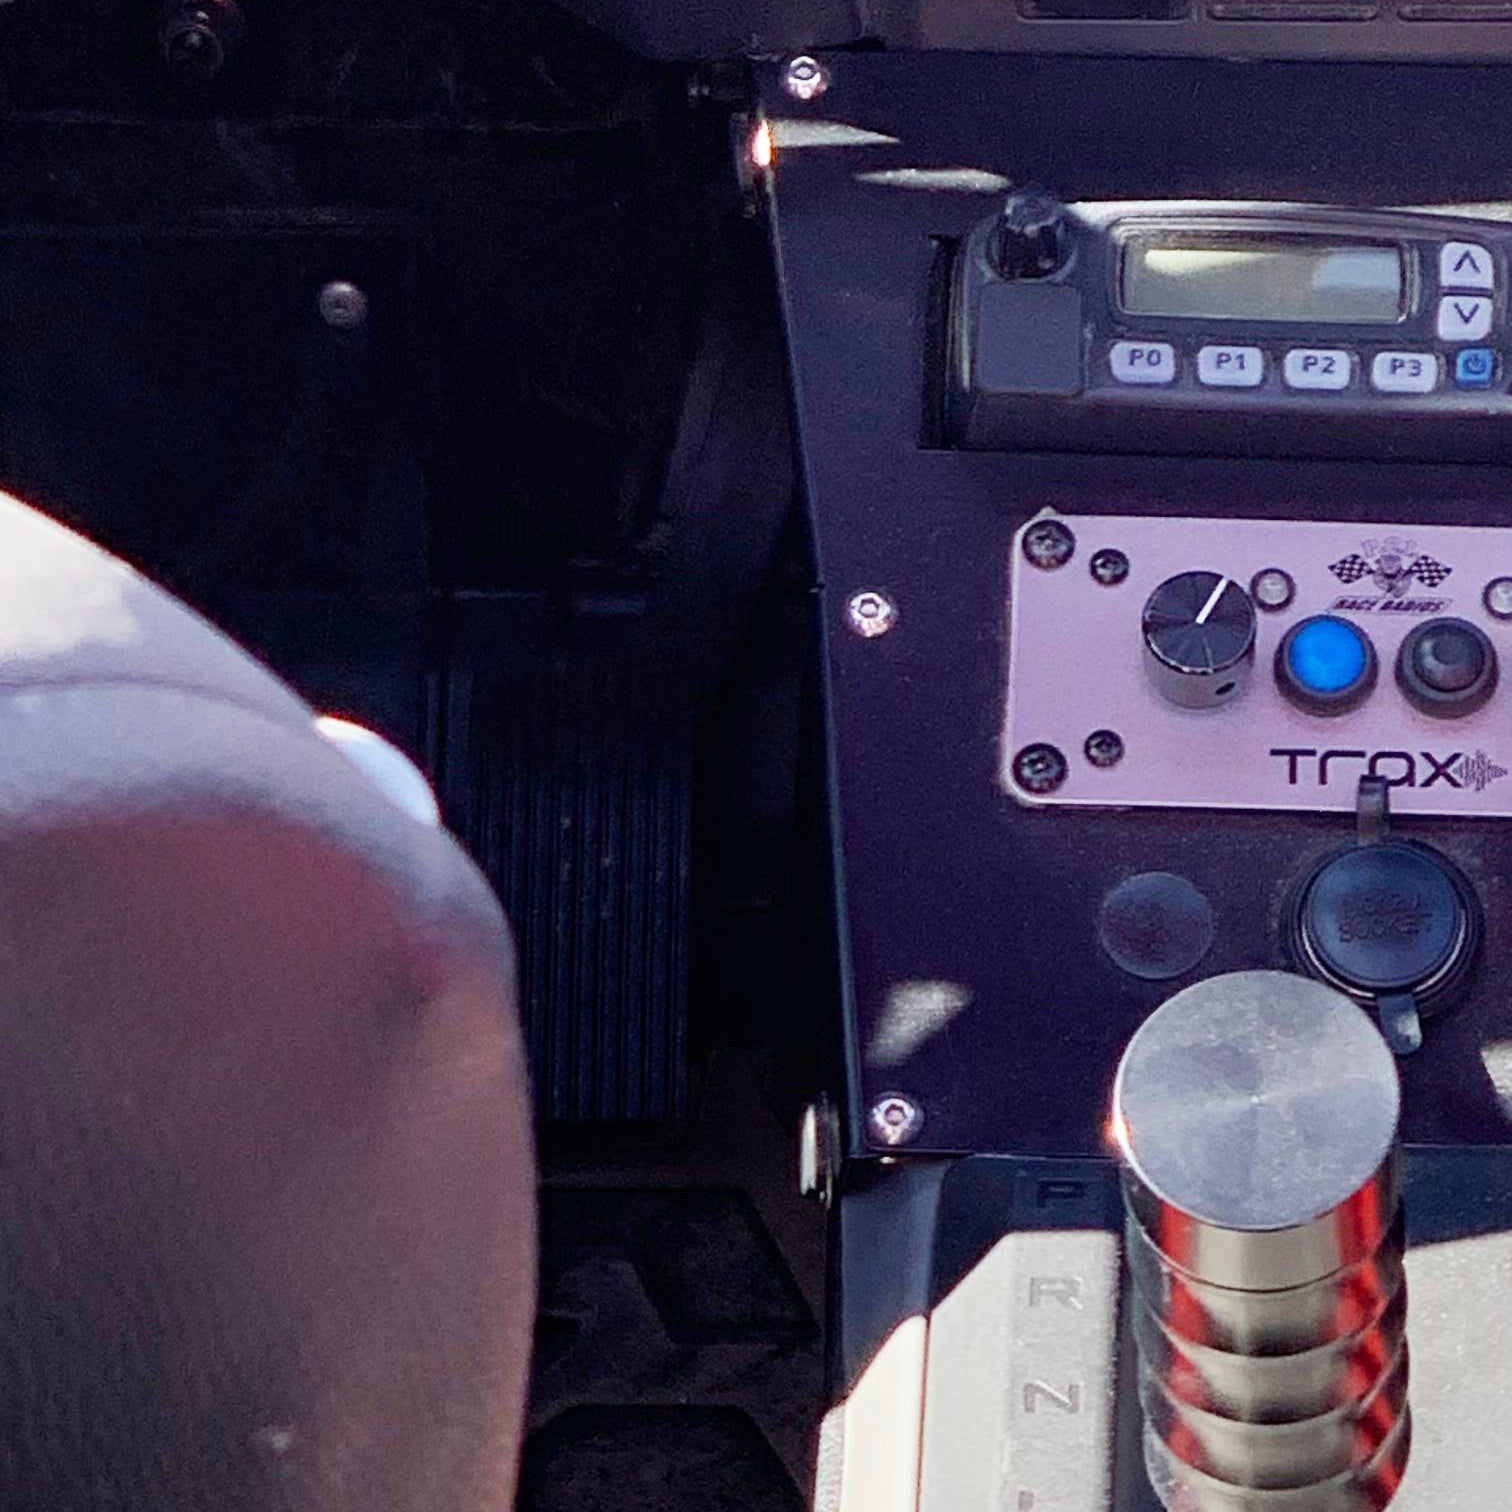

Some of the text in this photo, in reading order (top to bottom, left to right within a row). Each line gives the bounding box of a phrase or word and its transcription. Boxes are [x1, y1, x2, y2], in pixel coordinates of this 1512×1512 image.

[1215, 352, 1247, 370] P1
[1301, 355, 1337, 374] P2
[1389, 357, 1423, 377] P3
[1036, 1178, 1085, 1209] P
[1029, 1275, 1084, 1310] R
[1022, 1379, 1081, 1414] N
